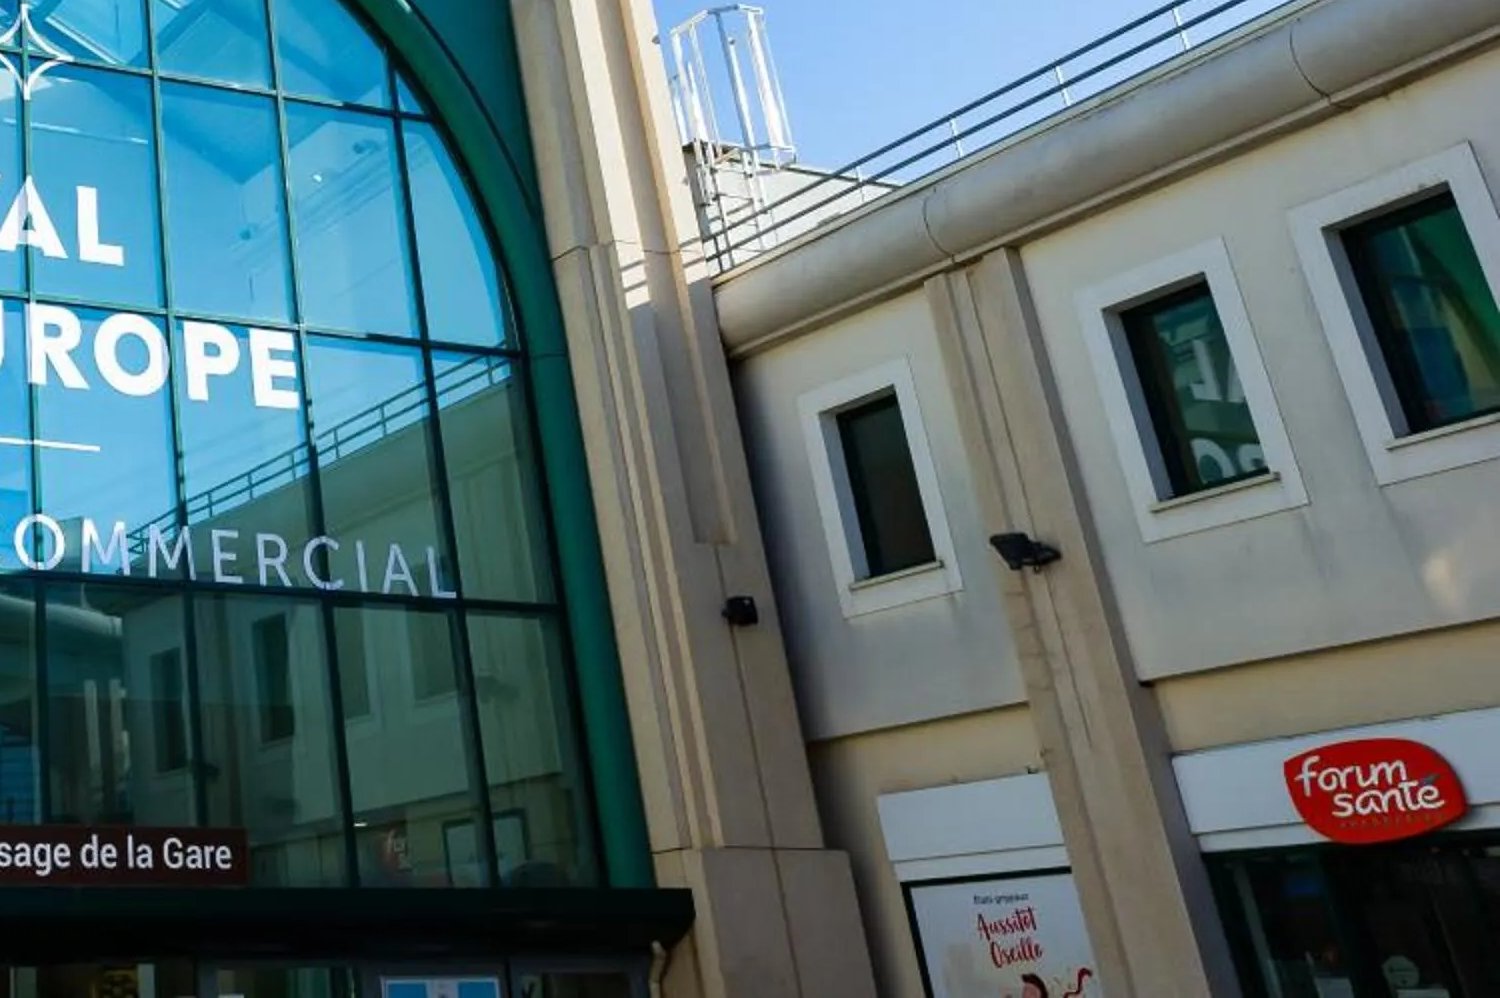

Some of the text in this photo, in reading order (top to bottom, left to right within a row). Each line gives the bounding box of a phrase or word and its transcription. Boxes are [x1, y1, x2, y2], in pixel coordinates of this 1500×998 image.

[1294, 754, 1408, 797] forum
[1331, 773, 1445, 818] santé
[80, 834, 118, 868] de
[126, 834, 153, 869] la
[163, 836, 233, 870] Gare
